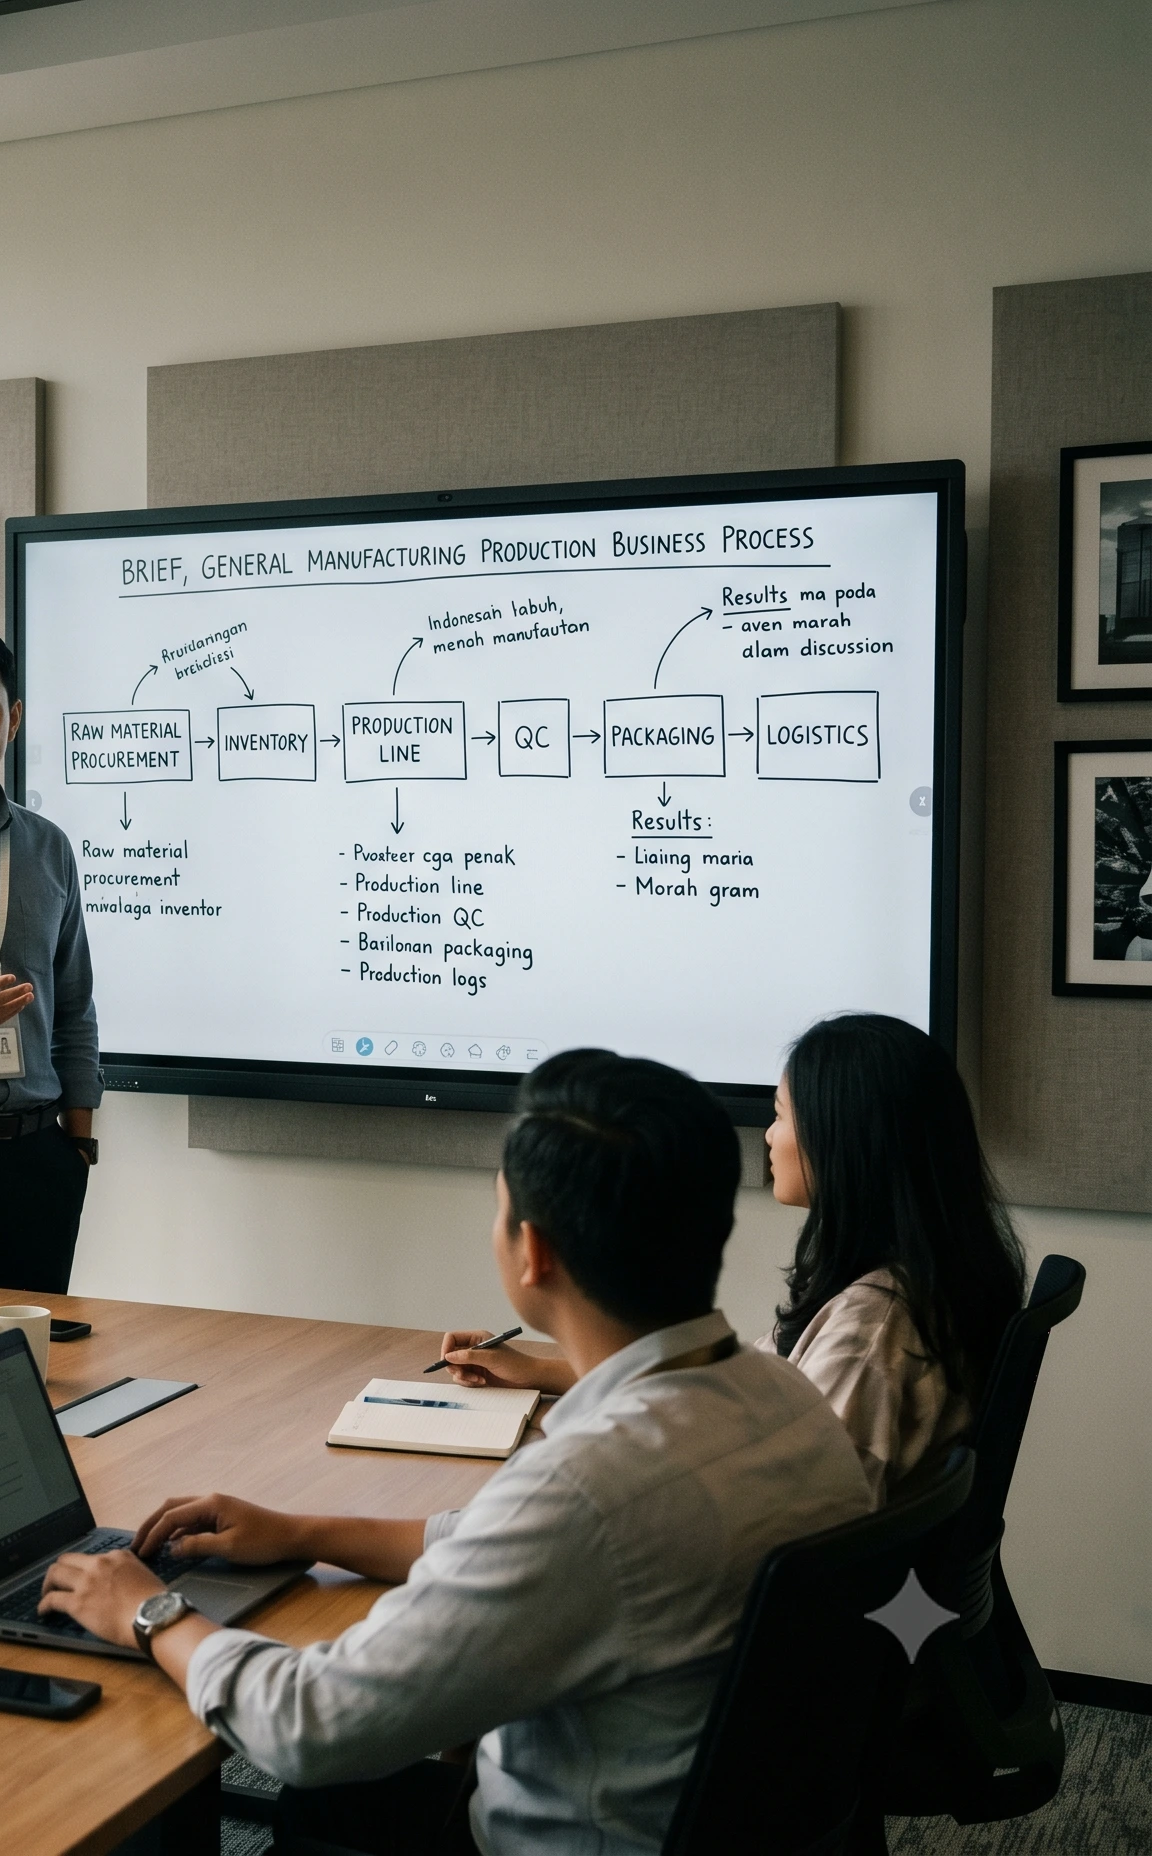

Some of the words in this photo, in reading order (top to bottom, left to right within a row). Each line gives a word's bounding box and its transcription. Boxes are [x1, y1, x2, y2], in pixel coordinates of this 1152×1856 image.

[122, 556, 188, 587] BRIEF,
[201, 552, 294, 580] GENERAL
[306, 544, 467, 574] MANUFACTURING
[481, 537, 596, 563] PRODUCTION
[612, 530, 706, 558] BUSINESS
[722, 524, 814, 554] PROCESS
[722, 584, 788, 607] Results
[799, 590, 826, 602] ma
[835, 581, 877, 609] poda
[741, 620, 783, 633] aven
[792, 612, 852, 629] marah
[800, 637, 894, 657] discussion
[70, 722, 104, 742] RAW
[111, 721, 182, 740] MATERIAL
[351, 715, 453, 737] PRODUCTION
[611, 724, 715, 748] PACKAGING
[767, 724, 869, 747] LOGISTICS
[224, 732, 309, 754] INVENTORY
[514, 725, 550, 751] QC
[71, 750, 180, 771] PROCUREMENT
[379, 743, 421, 763] LINE
[82, 839, 115, 858] Raw
[123, 839, 189, 859] material
[422, 851, 454, 872] cga
[464, 844, 516, 870] penak
[702, 849, 754, 867] maria
[83, 867, 181, 891] procurement
[355, 872, 440, 894] Production
[451, 875, 485, 896] line
[159, 898, 223, 917] inventor
[709, 885, 760, 908] gram
[357, 901, 442, 925] Production
[453, 906, 485, 931] QC
[443, 938, 534, 972] packaging
[452, 966, 487, 997] logs
